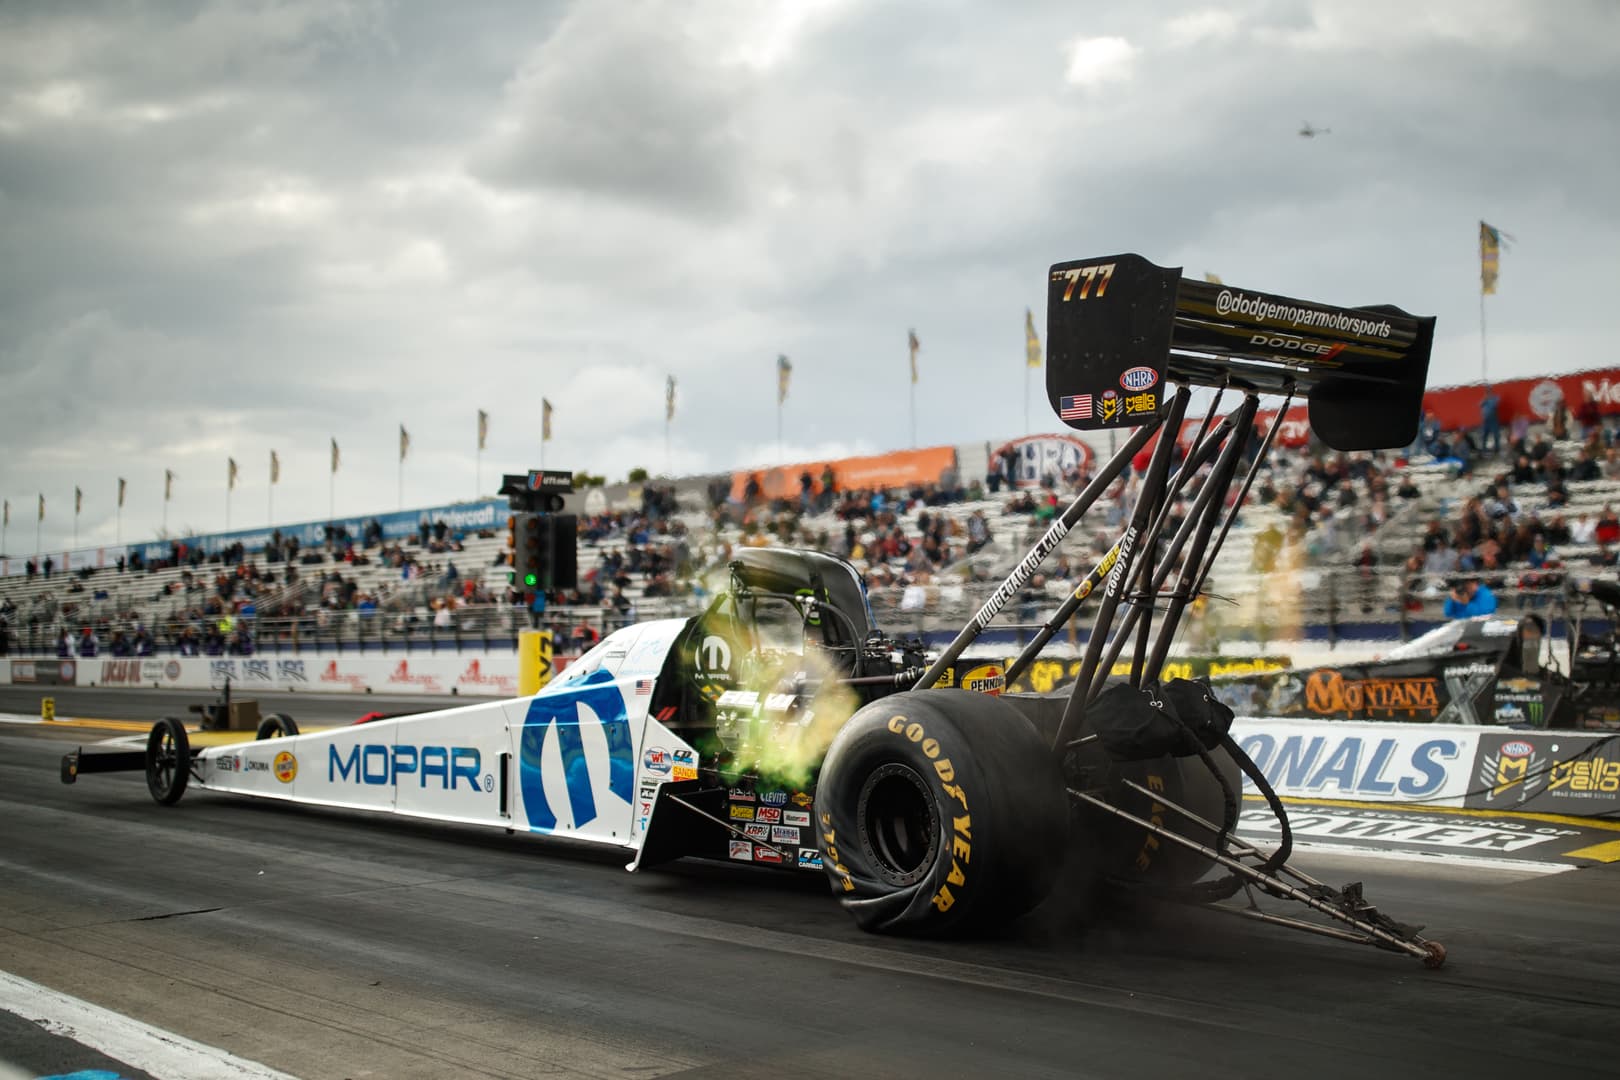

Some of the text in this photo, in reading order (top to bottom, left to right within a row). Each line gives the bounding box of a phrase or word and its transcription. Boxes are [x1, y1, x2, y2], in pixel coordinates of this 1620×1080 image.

[1063, 263, 1117, 302] 777
[1216, 289, 1391, 338] @dodgemoparmotorsports
[1250, 335, 1333, 355] DODGE
[1125, 370, 1154, 387] NHRA
[976, 519, 1069, 629] DODGEGARAGE.COM
[1107, 526, 1138, 598] GOODYEAR
[1306, 669, 1438, 714] MONTANA
[1232, 733, 1458, 797] ONALS
[1504, 743, 1530, 756] NHRA
[746, 825, 763, 835] XRP
[759, 808, 780, 819] MSD
[887, 715, 973, 913] GOODYEAR
[1535, 827, 1582, 836] OF
